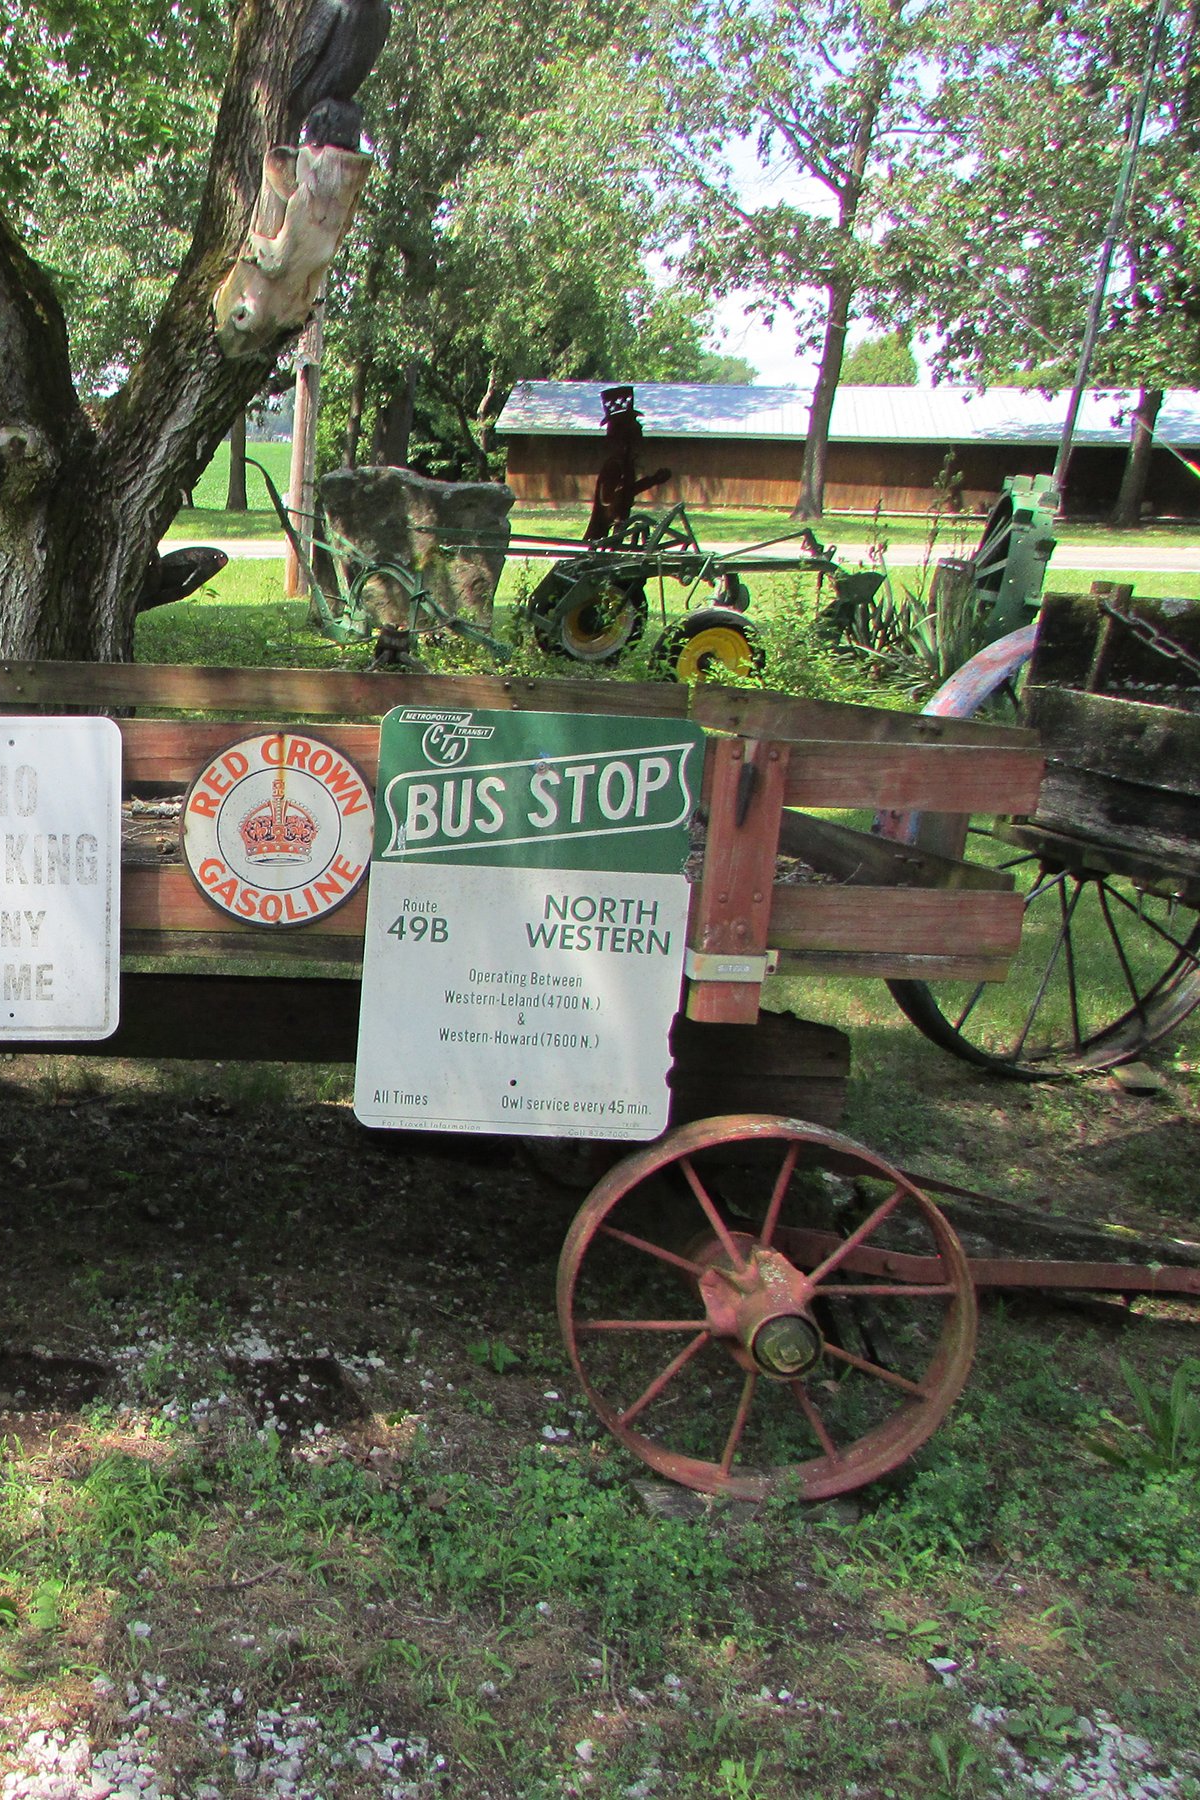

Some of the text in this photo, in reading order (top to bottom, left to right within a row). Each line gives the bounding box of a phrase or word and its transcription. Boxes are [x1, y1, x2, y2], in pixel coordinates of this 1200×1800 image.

[405, 712, 462, 722] METROPOLITAN
[457, 728, 490, 736] TRANSIT
[430, 725, 460, 760] CTA
[189, 737, 369, 819] RED CROWN
[405, 757, 671, 842] BUS STOP
[198, 853, 363, 922] GASOLINE
[402, 898, 438, 913] Route
[544, 894, 658, 926] NORTH
[387, 915, 449, 943] 49B
[525, 922, 671, 956] WESTERN
[468, 968, 583, 988] Operating Between
[517, 1012, 525, 1026] &
[373, 1089, 428, 1106] All Times
[501, 1095, 652, 1116] Owl service every 45 min.
[430, 1121, 481, 1131] Information
[568, 1129, 585, 1137] Call
